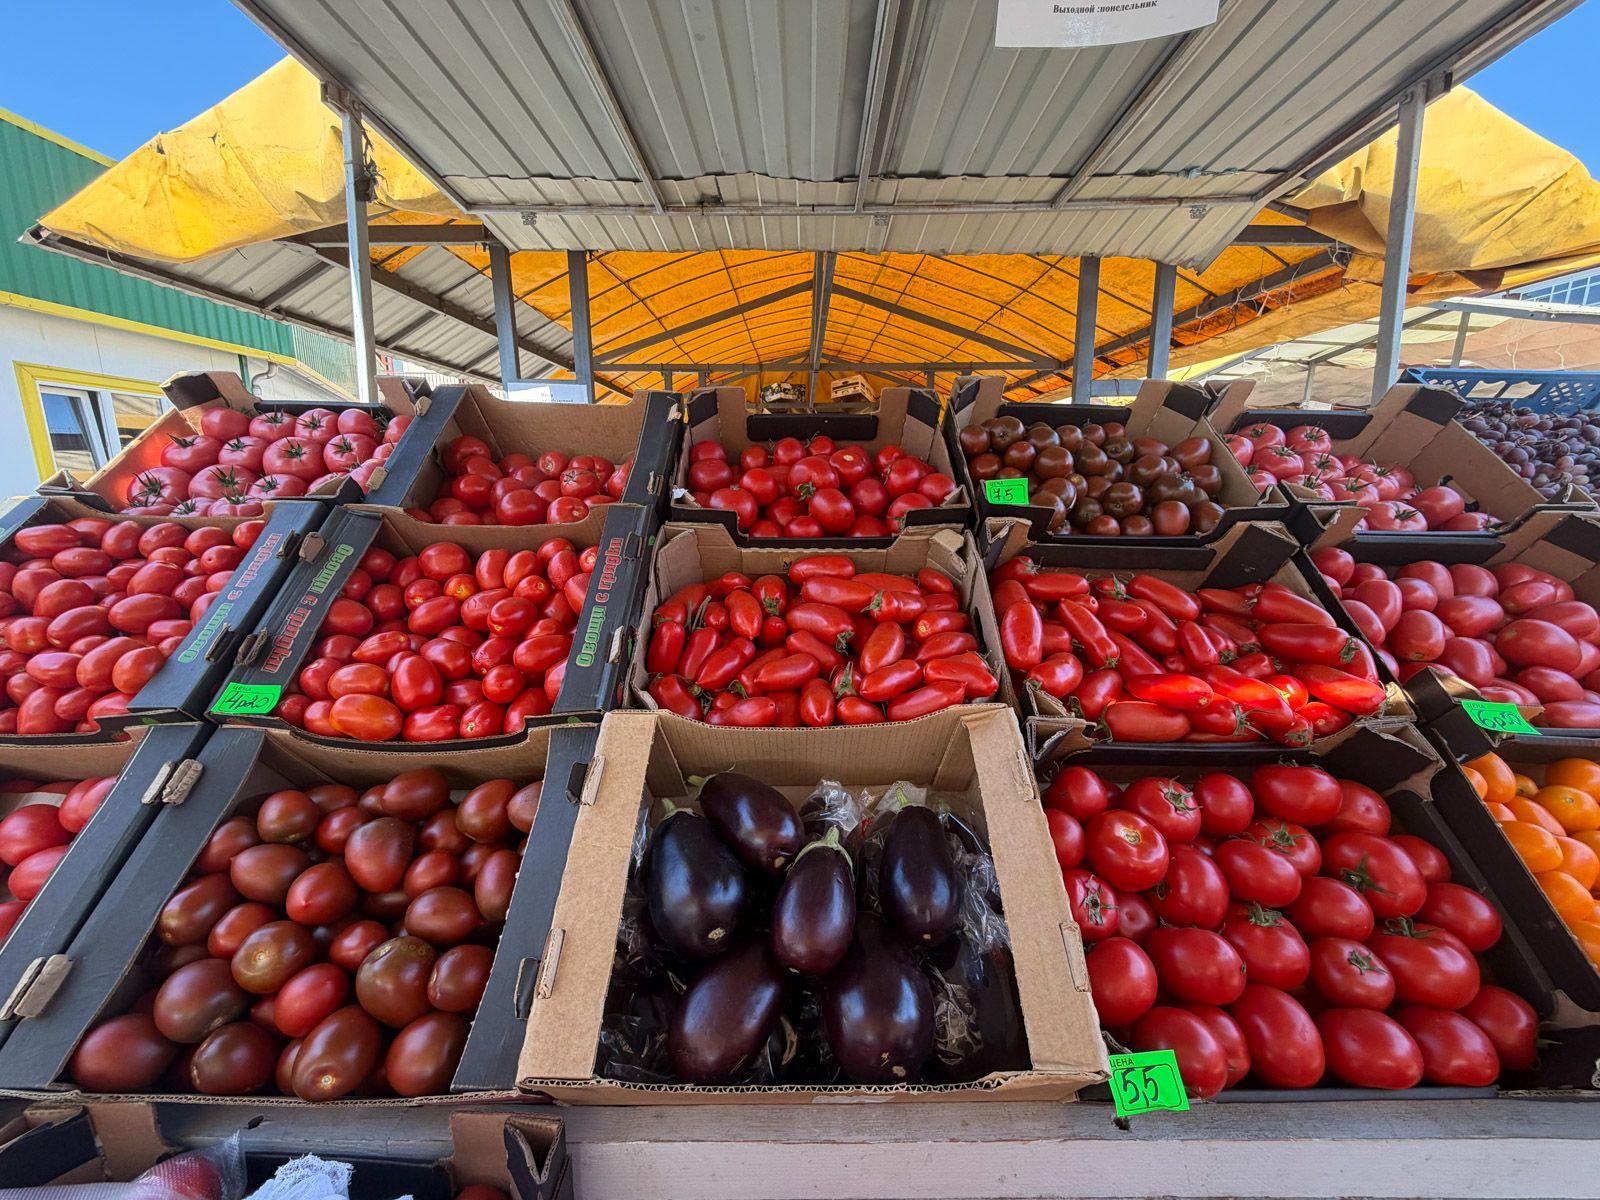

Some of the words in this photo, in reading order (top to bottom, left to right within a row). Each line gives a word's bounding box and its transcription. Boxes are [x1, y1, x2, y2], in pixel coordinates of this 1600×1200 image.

[1053, 4, 1095, 14] Выходной
[309, 543, 354, 594] Овощи
[597, 537, 624, 591] грядки
[177, 602, 234, 664] Овощи
[227, 589, 243, 601] с
[235, 532, 283, 588] грядки
[301, 594, 318, 606] с
[595, 592, 610, 603] с
[260, 606, 312, 674] грядки
[576, 605, 607, 667] Овощи
[1109, 1057, 1135, 1068] ЦЕНА
[1121, 1066, 1159, 1108] 5,5
